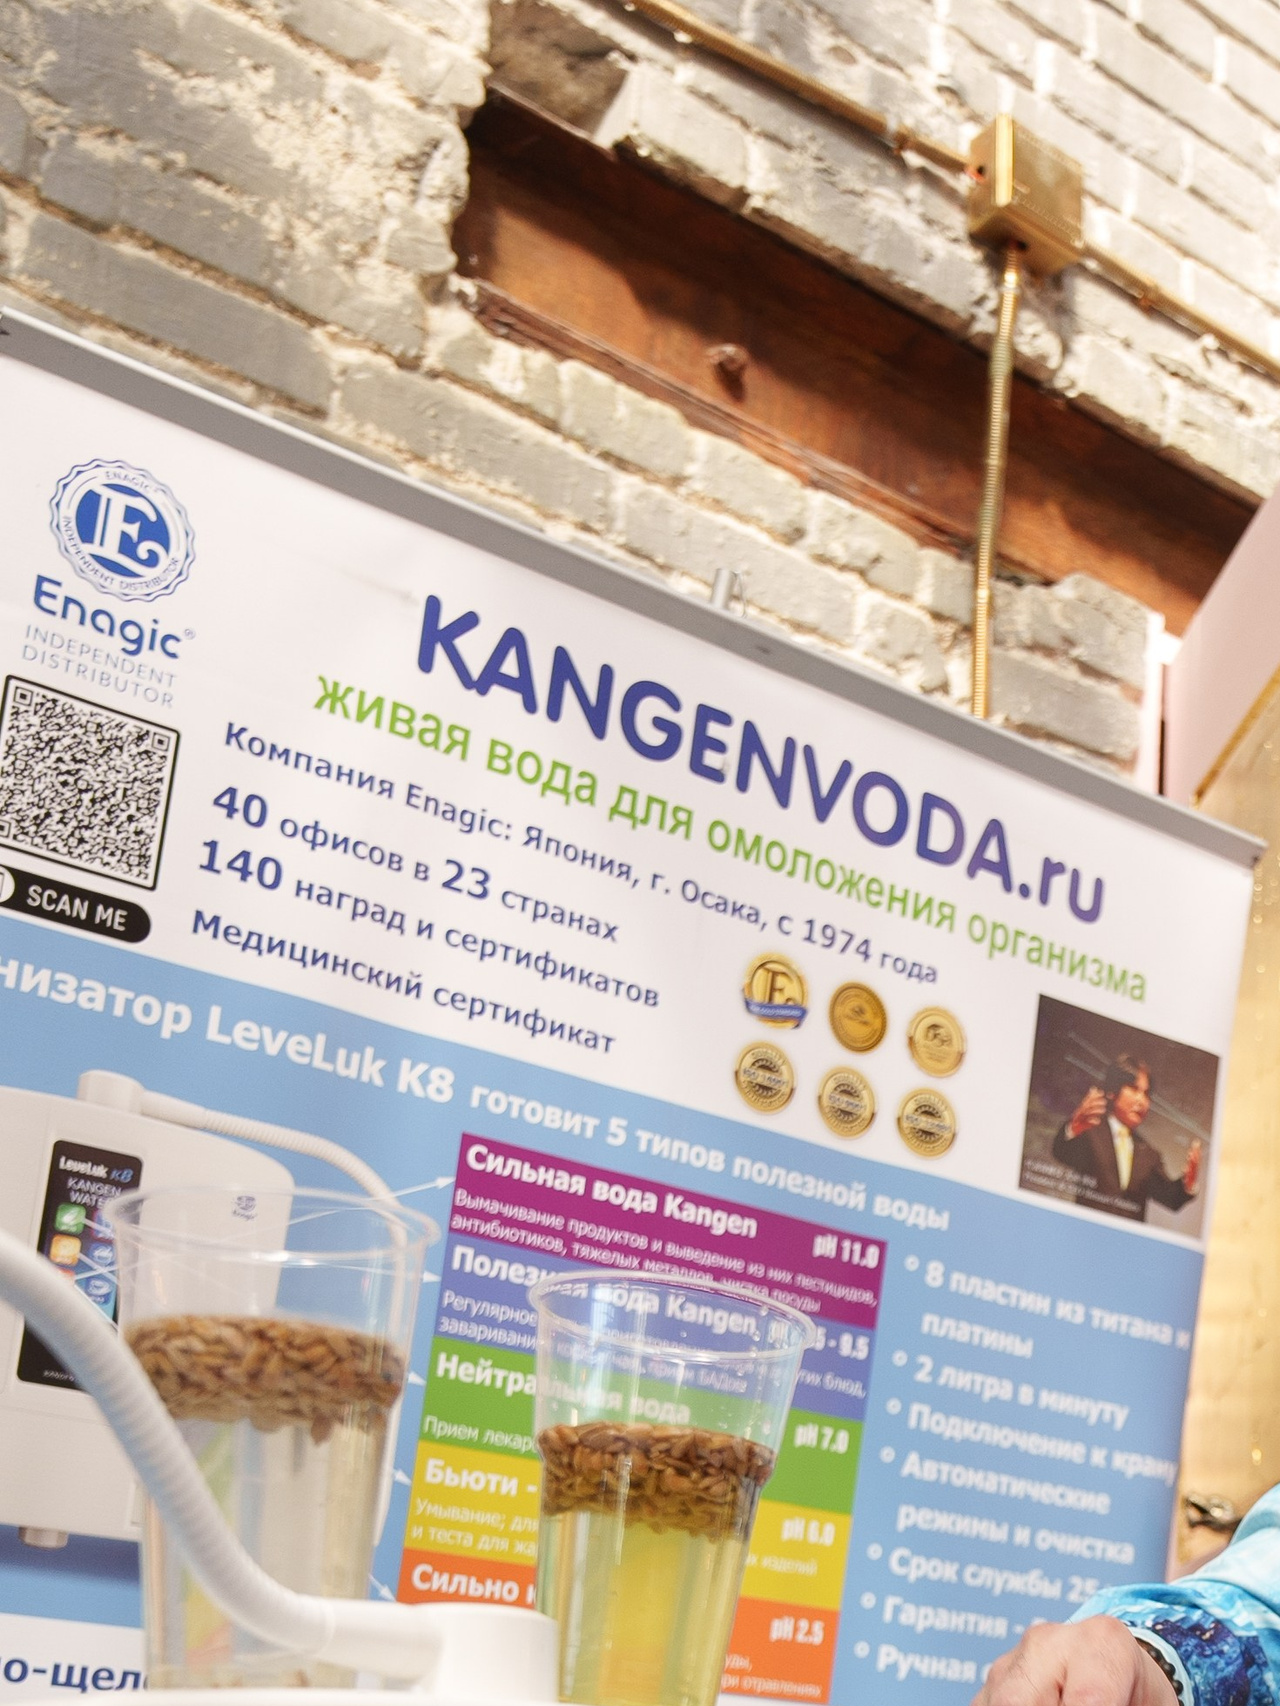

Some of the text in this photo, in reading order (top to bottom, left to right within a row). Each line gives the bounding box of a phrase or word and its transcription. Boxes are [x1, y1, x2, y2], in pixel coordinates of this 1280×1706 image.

[22, 644, 174, 708] DISTRIBUTOR
[25, 624, 177, 688] INDEPENDENT
[417, 594, 1104, 924] KANGENVODA.ru
[213, 786, 619, 943] 40 офисов в 23 странах
[225, 722, 939, 985] Компания Enagic: Япония, г. Осака, с 1974 года
[313, 675, 1148, 1003] живая вода для омоложения организма
[26, 884, 129, 932] SCAN ME
[198, 839, 660, 1007] 140 наград и сертификатов
[191, 909, 616, 1053] Медицинский сертификат
[206, 1005, 387, 1087] LeveLuk
[397, 1059, 456, 1103] K8
[470, 1081, 600, 1140] готовит
[606, 1117, 628, 1147] 5
[635, 1128, 726, 1176] типов
[732, 1157, 868, 1213] полезной
[872, 1192, 949, 1232] воды
[69, 1190, 108, 1209] WATE
[466, 1143, 758, 1239] Сильная вода Kangen
[451, 1213, 568, 1256] антибиотиков,
[572, 1241, 640, 1270] тяжелых
[454, 1188, 565, 1232] Вымачивание
[567, 1218, 649, 1252] продуктов
[651, 1239, 662, 1253] и
[665, 1240, 746, 1274] выведение
[747, 1262, 765, 1278] из
[812, 1233, 881, 1269] pH 11.0
[924, 1258, 945, 1288] 8
[949, 1270, 1050, 1317] пластин
[1055, 1298, 1086, 1325] из
[1090, 1306, 1174, 1347] титана
[921, 1312, 1034, 1359] платины
[914, 1354, 1130, 1432] 2 литра в минуту
[794, 1422, 850, 1454] pH 7.0
[908, 1401, 1086, 1465] Подключение
[1090, 1445, 1107, 1469] к
[425, 1457, 519, 1497] Бьюти
[901, 1450, 1111, 1515] Автоматические
[411, 1524, 423, 1539] и
[428, 1525, 474, 1547] теста
[478, 1532, 509, 1551] для
[781, 1517, 804, 1543] pH
[896, 1503, 1135, 1566] режимы и очистка
[411, 1562, 519, 1603] Сильно
[888, 1545, 959, 1585] Срок
[963, 1562, 1062, 1598] службы
[769, 1616, 825, 1646] pH 2.5
[882, 1594, 1009, 1640] Гарантия
[3, 1656, 148, 1694] о-щел
[876, 1642, 977, 1682] Ручная
